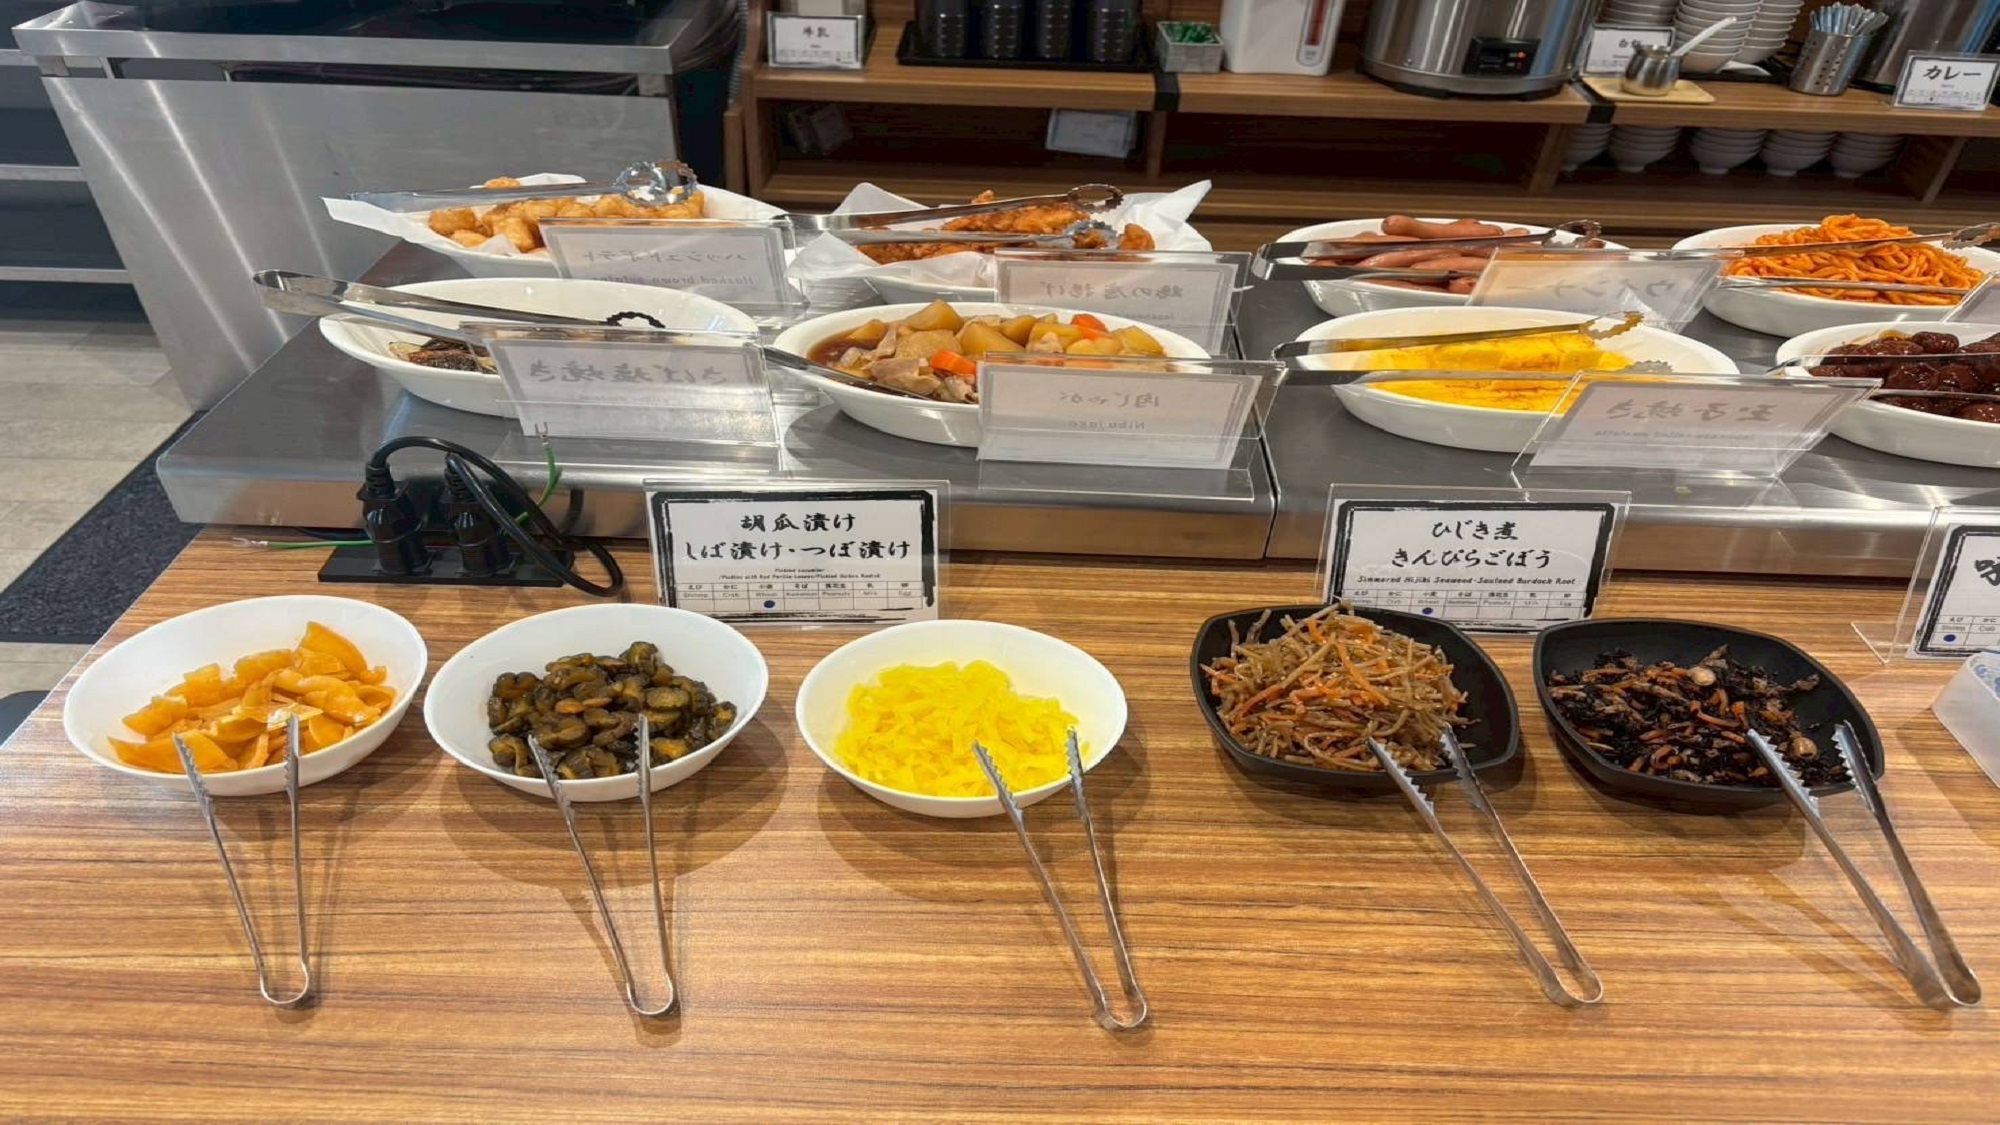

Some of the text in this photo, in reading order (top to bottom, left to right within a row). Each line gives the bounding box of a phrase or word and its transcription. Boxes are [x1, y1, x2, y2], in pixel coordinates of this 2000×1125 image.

[1923, 65, 1981, 80] カレー
[740, 512, 857, 532] 胡瓜漬け
[1431, 520, 1519, 540] ひじき煮
[685, 540, 911, 561] しば漬け・つぼ漬け
[1391, 547, 1552, 568] きんぴらごぼう
